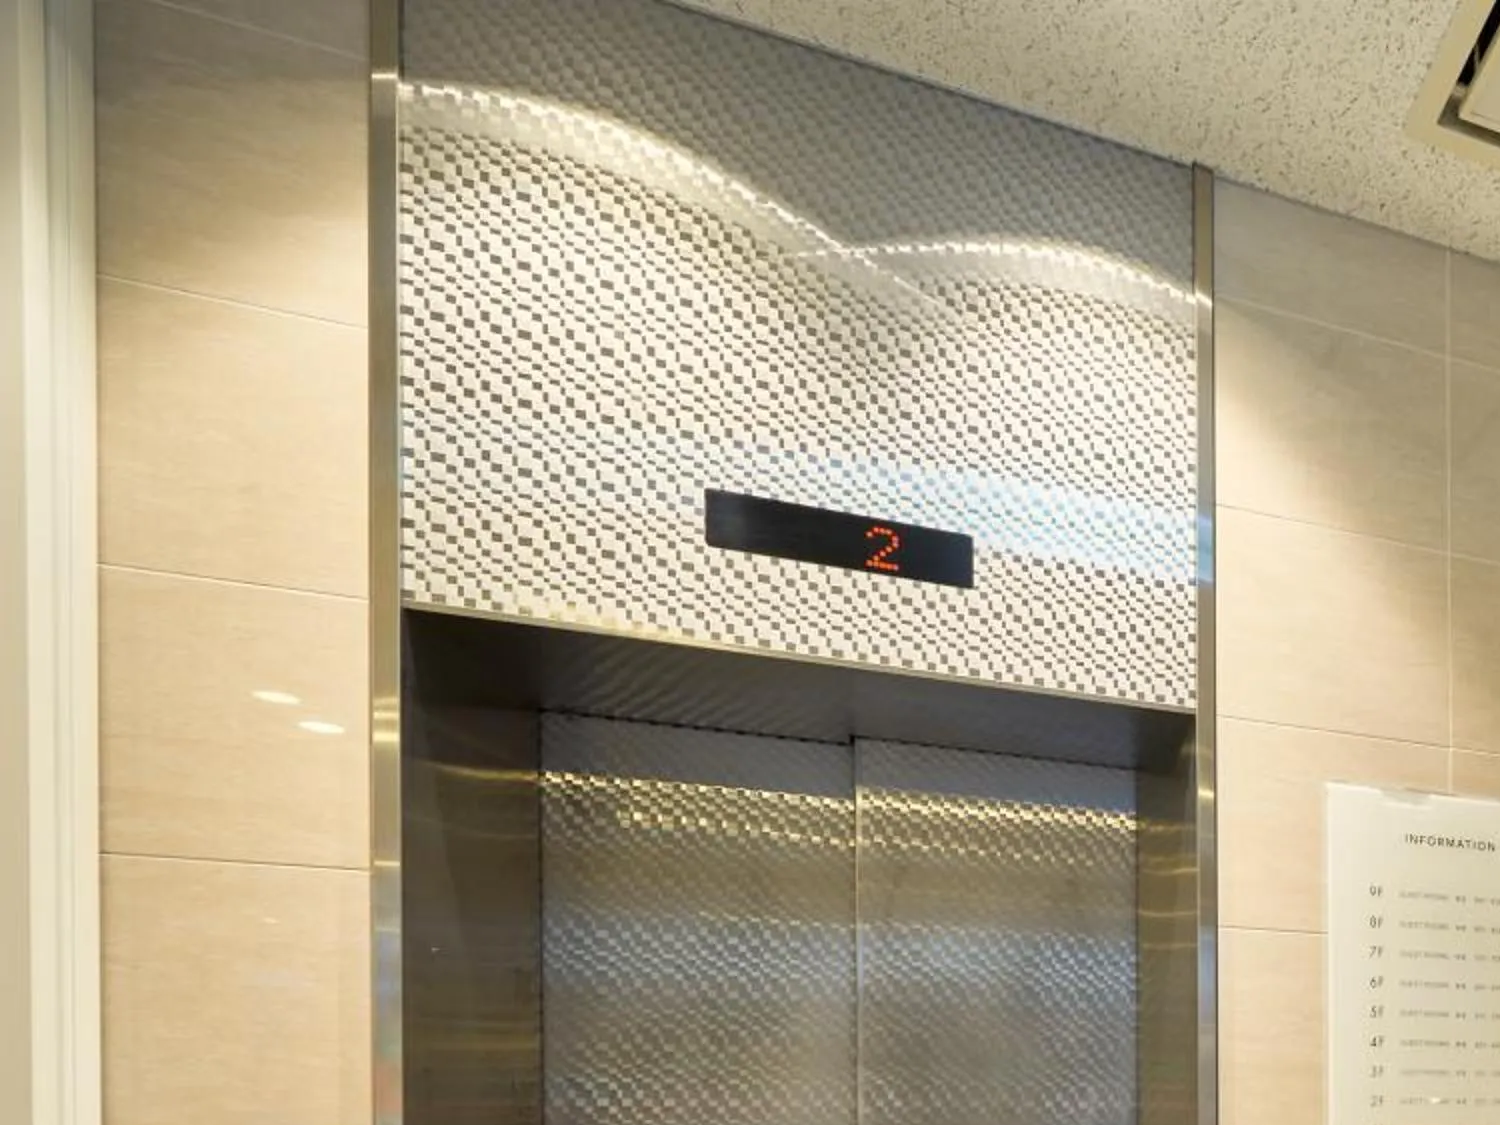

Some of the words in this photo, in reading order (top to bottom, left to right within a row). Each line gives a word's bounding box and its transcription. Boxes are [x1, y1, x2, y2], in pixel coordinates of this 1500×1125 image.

[865, 526, 901, 571] 2
[1405, 833, 1496, 852] INFORMATION
[1369, 915, 1383, 929] 8F
[1368, 945, 1383, 958] 7F
[1369, 975, 1384, 989] 6F
[1369, 1005, 1384, 1019] 5F
[1369, 1034, 1385, 1048] 4F
